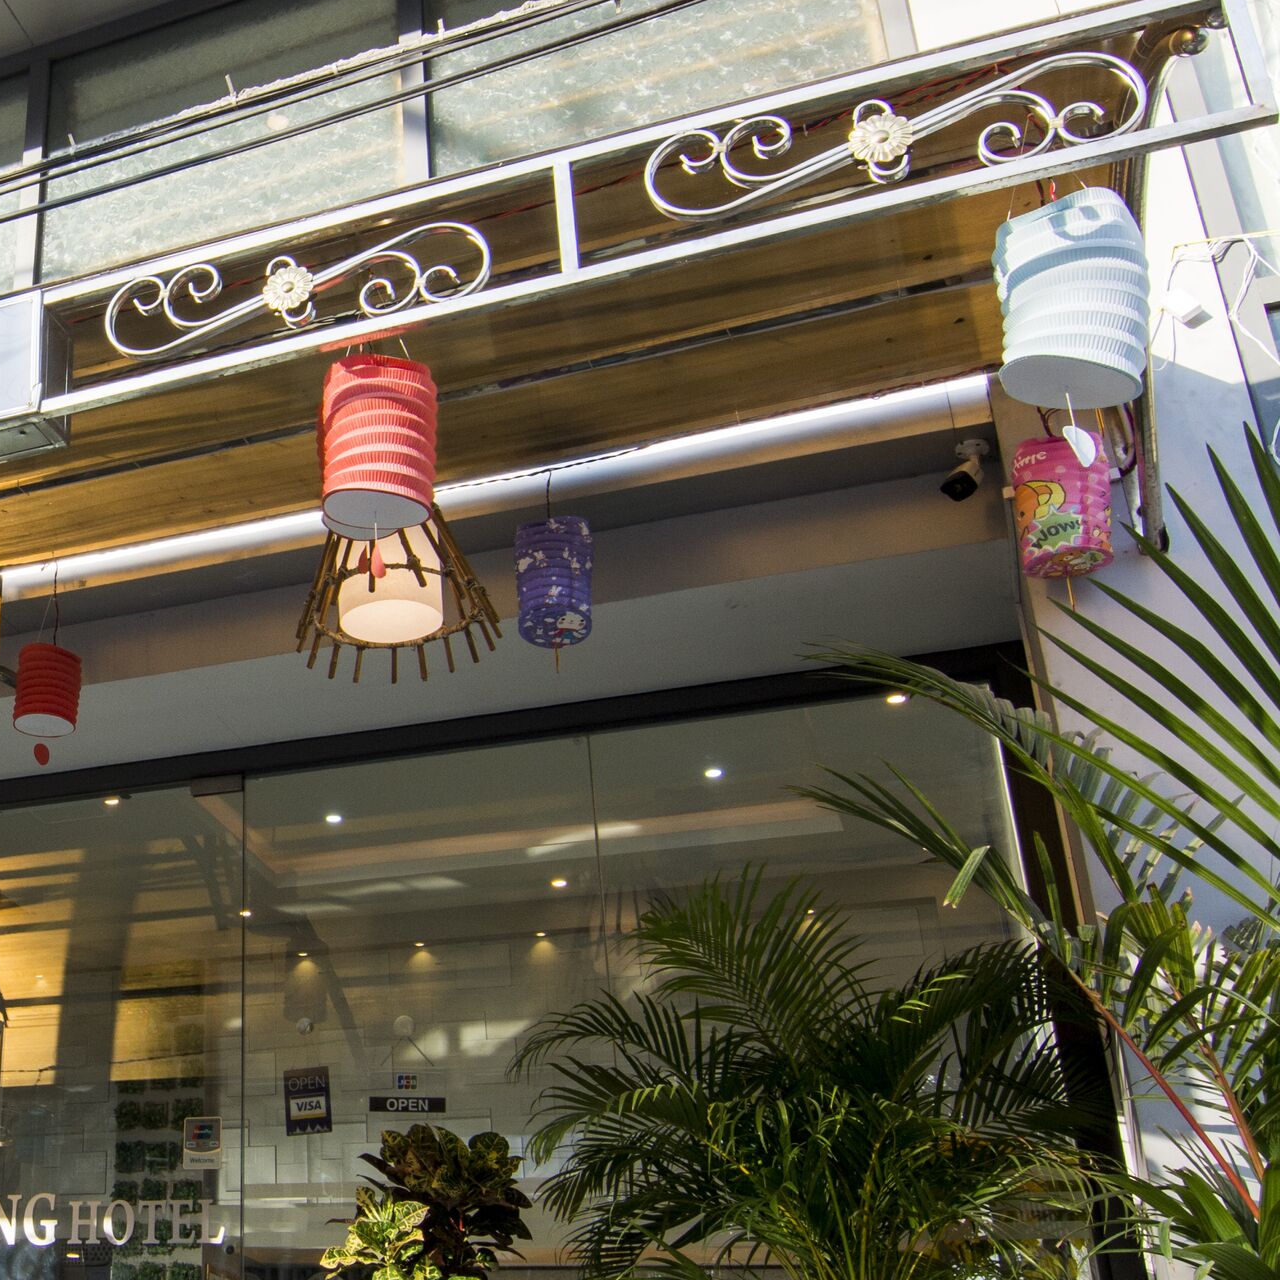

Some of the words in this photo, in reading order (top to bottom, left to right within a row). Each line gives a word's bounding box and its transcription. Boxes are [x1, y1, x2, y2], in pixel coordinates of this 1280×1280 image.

[288, 1075, 326, 1092] OPEN
[398, 1076, 418, 1089] JCB
[296, 1099, 323, 1113] VISA
[386, 1098, 429, 1112] OPEN
[67, 1199, 225, 1246] HOTEL
